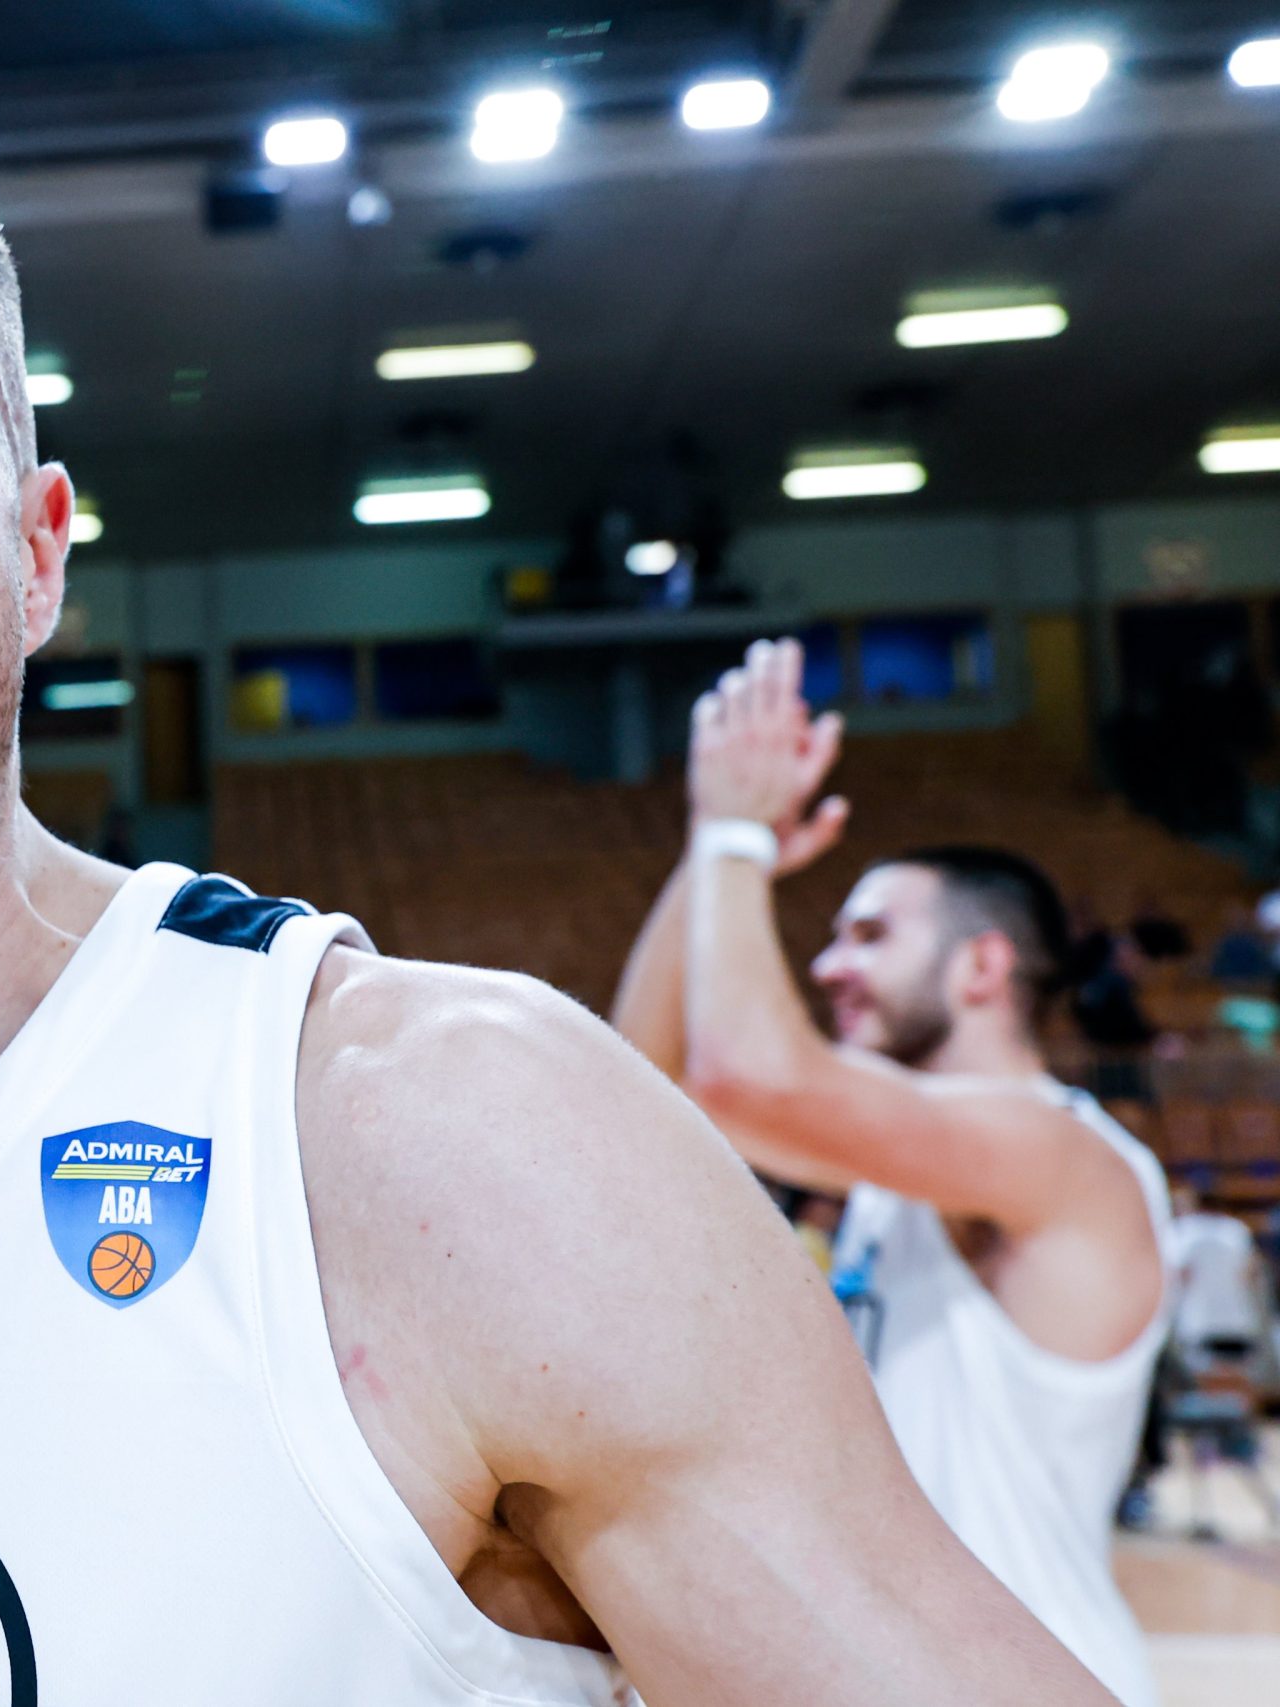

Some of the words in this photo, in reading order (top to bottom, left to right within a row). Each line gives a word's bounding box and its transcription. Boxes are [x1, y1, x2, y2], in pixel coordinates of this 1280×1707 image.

[61, 1139, 204, 1165] ADMIRAL
[151, 1166, 203, 1183] BET
[98, 1185, 153, 1225] ABA
